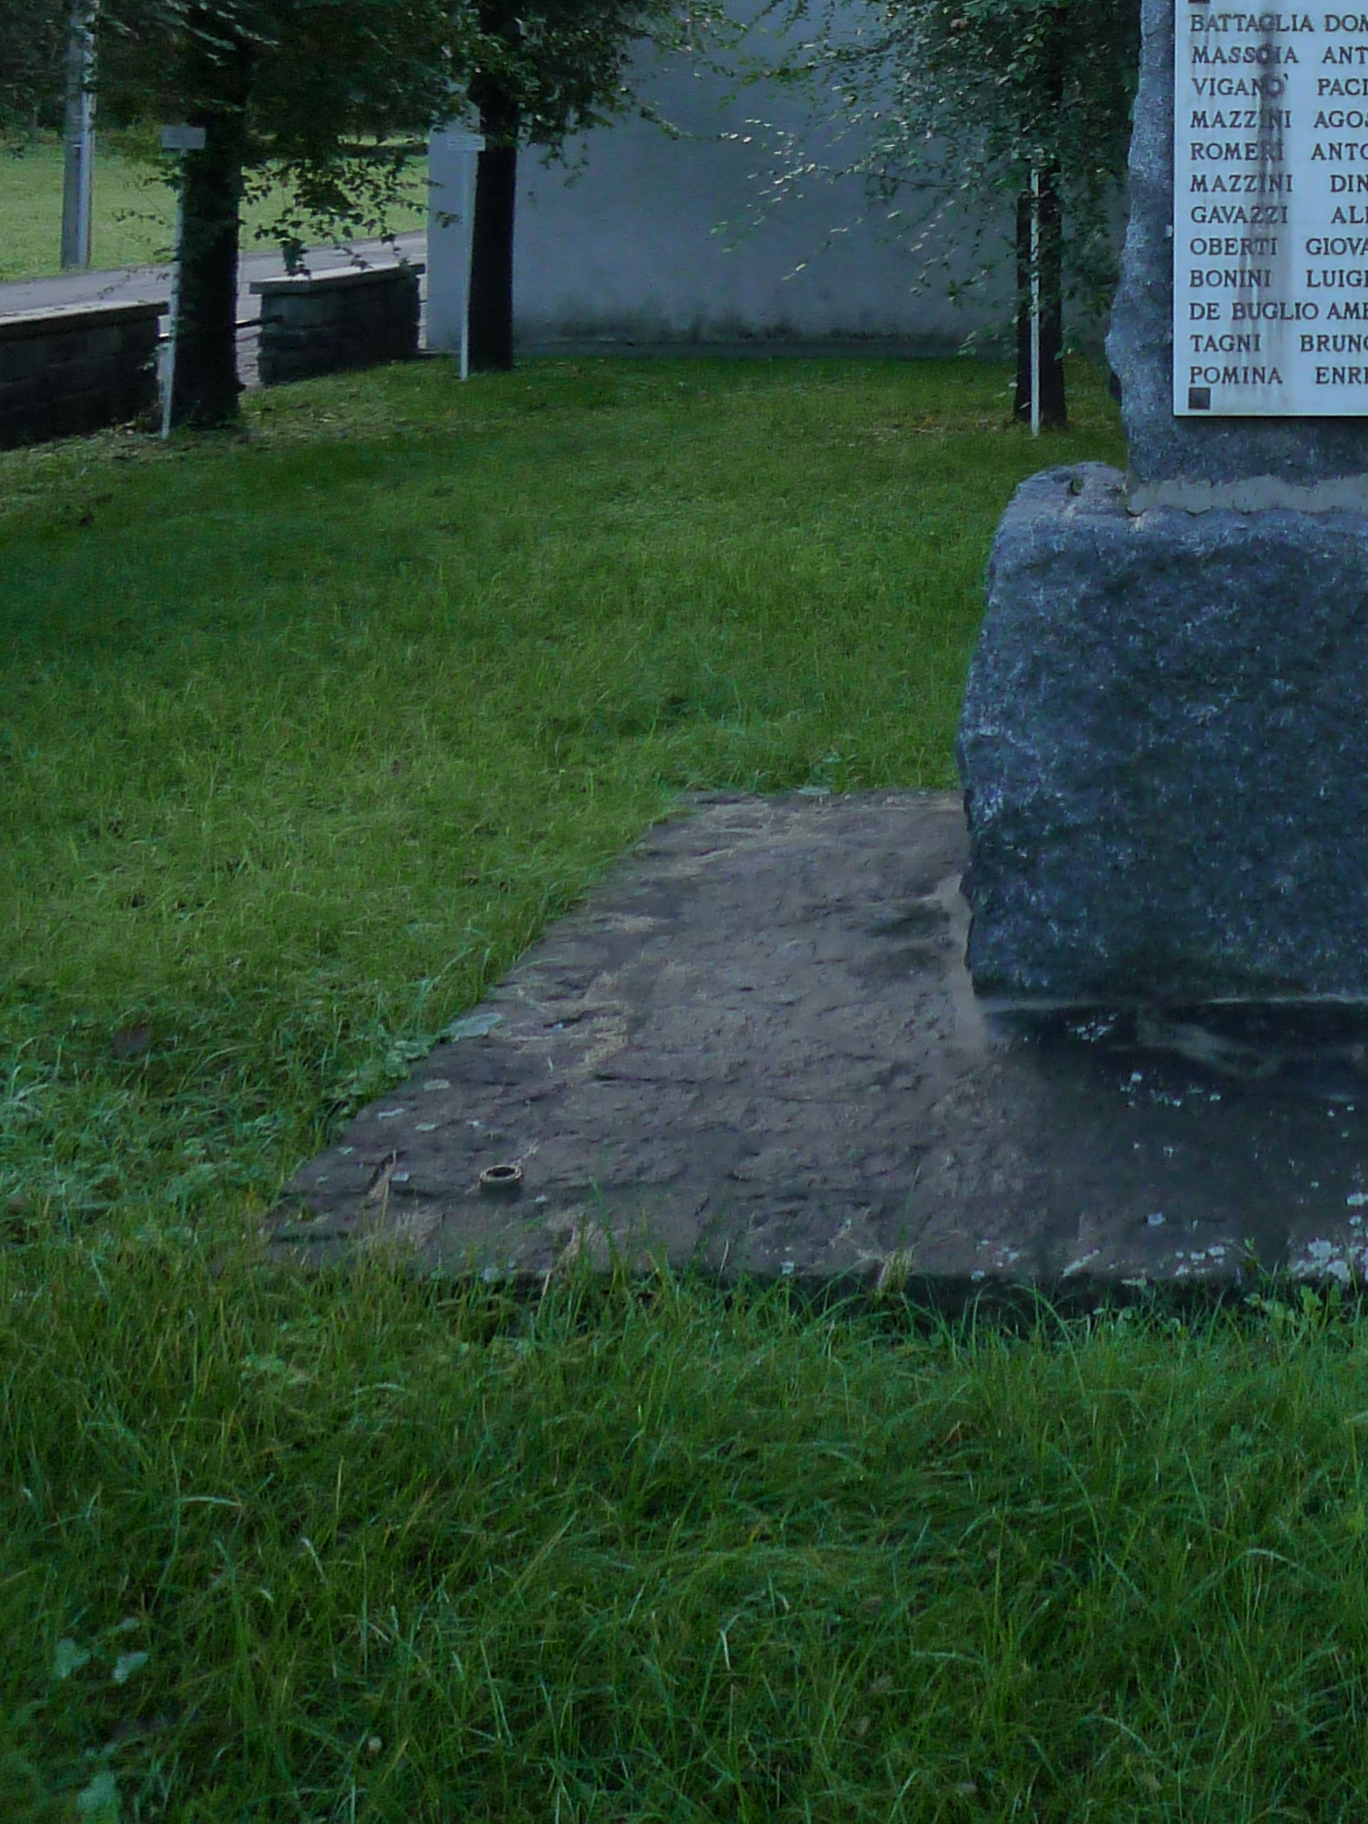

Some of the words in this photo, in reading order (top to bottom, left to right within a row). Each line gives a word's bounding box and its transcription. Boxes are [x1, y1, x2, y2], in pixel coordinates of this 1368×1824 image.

[1190, 13, 1315, 33] BATTAGLIA
[1190, 110, 1292, 129] MAZZINI
[1190, 142, 1284, 161] ROMERI
[1190, 174, 1293, 193] MAZZINI
[1190, 205, 1288, 225] GAVAZZI
[1190, 237, 1278, 256] OBERTI
[1189, 269, 1271, 289] BONINI
[1189, 301, 1221, 321] DE
[1232, 301, 1319, 321] BUGLIO
[1190, 334, 1261, 353] TAGNI
[1190, 366, 1283, 385] POMINA
